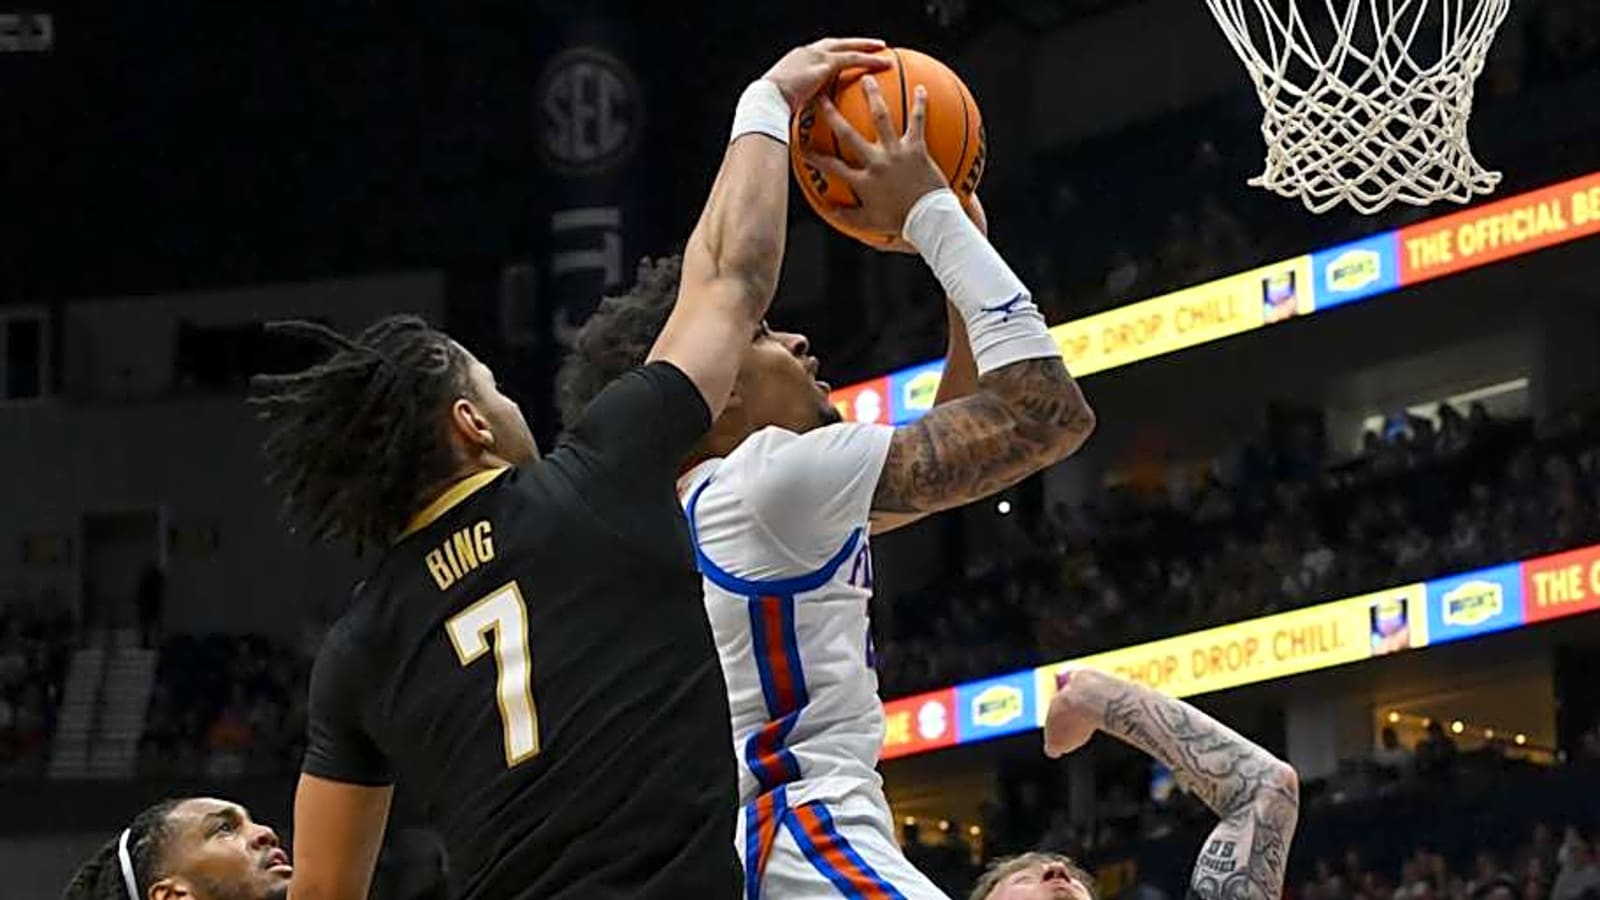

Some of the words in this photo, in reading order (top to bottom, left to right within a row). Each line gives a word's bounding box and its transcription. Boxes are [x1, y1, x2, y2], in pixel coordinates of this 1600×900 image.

[544, 63, 631, 161] SEC
[1406, 230, 1452, 269] THE
[1458, 199, 1567, 256] OFFICIAL
[425, 519, 495, 592] BING
[1532, 564, 1585, 608] THE
[444, 579, 541, 769] 7
